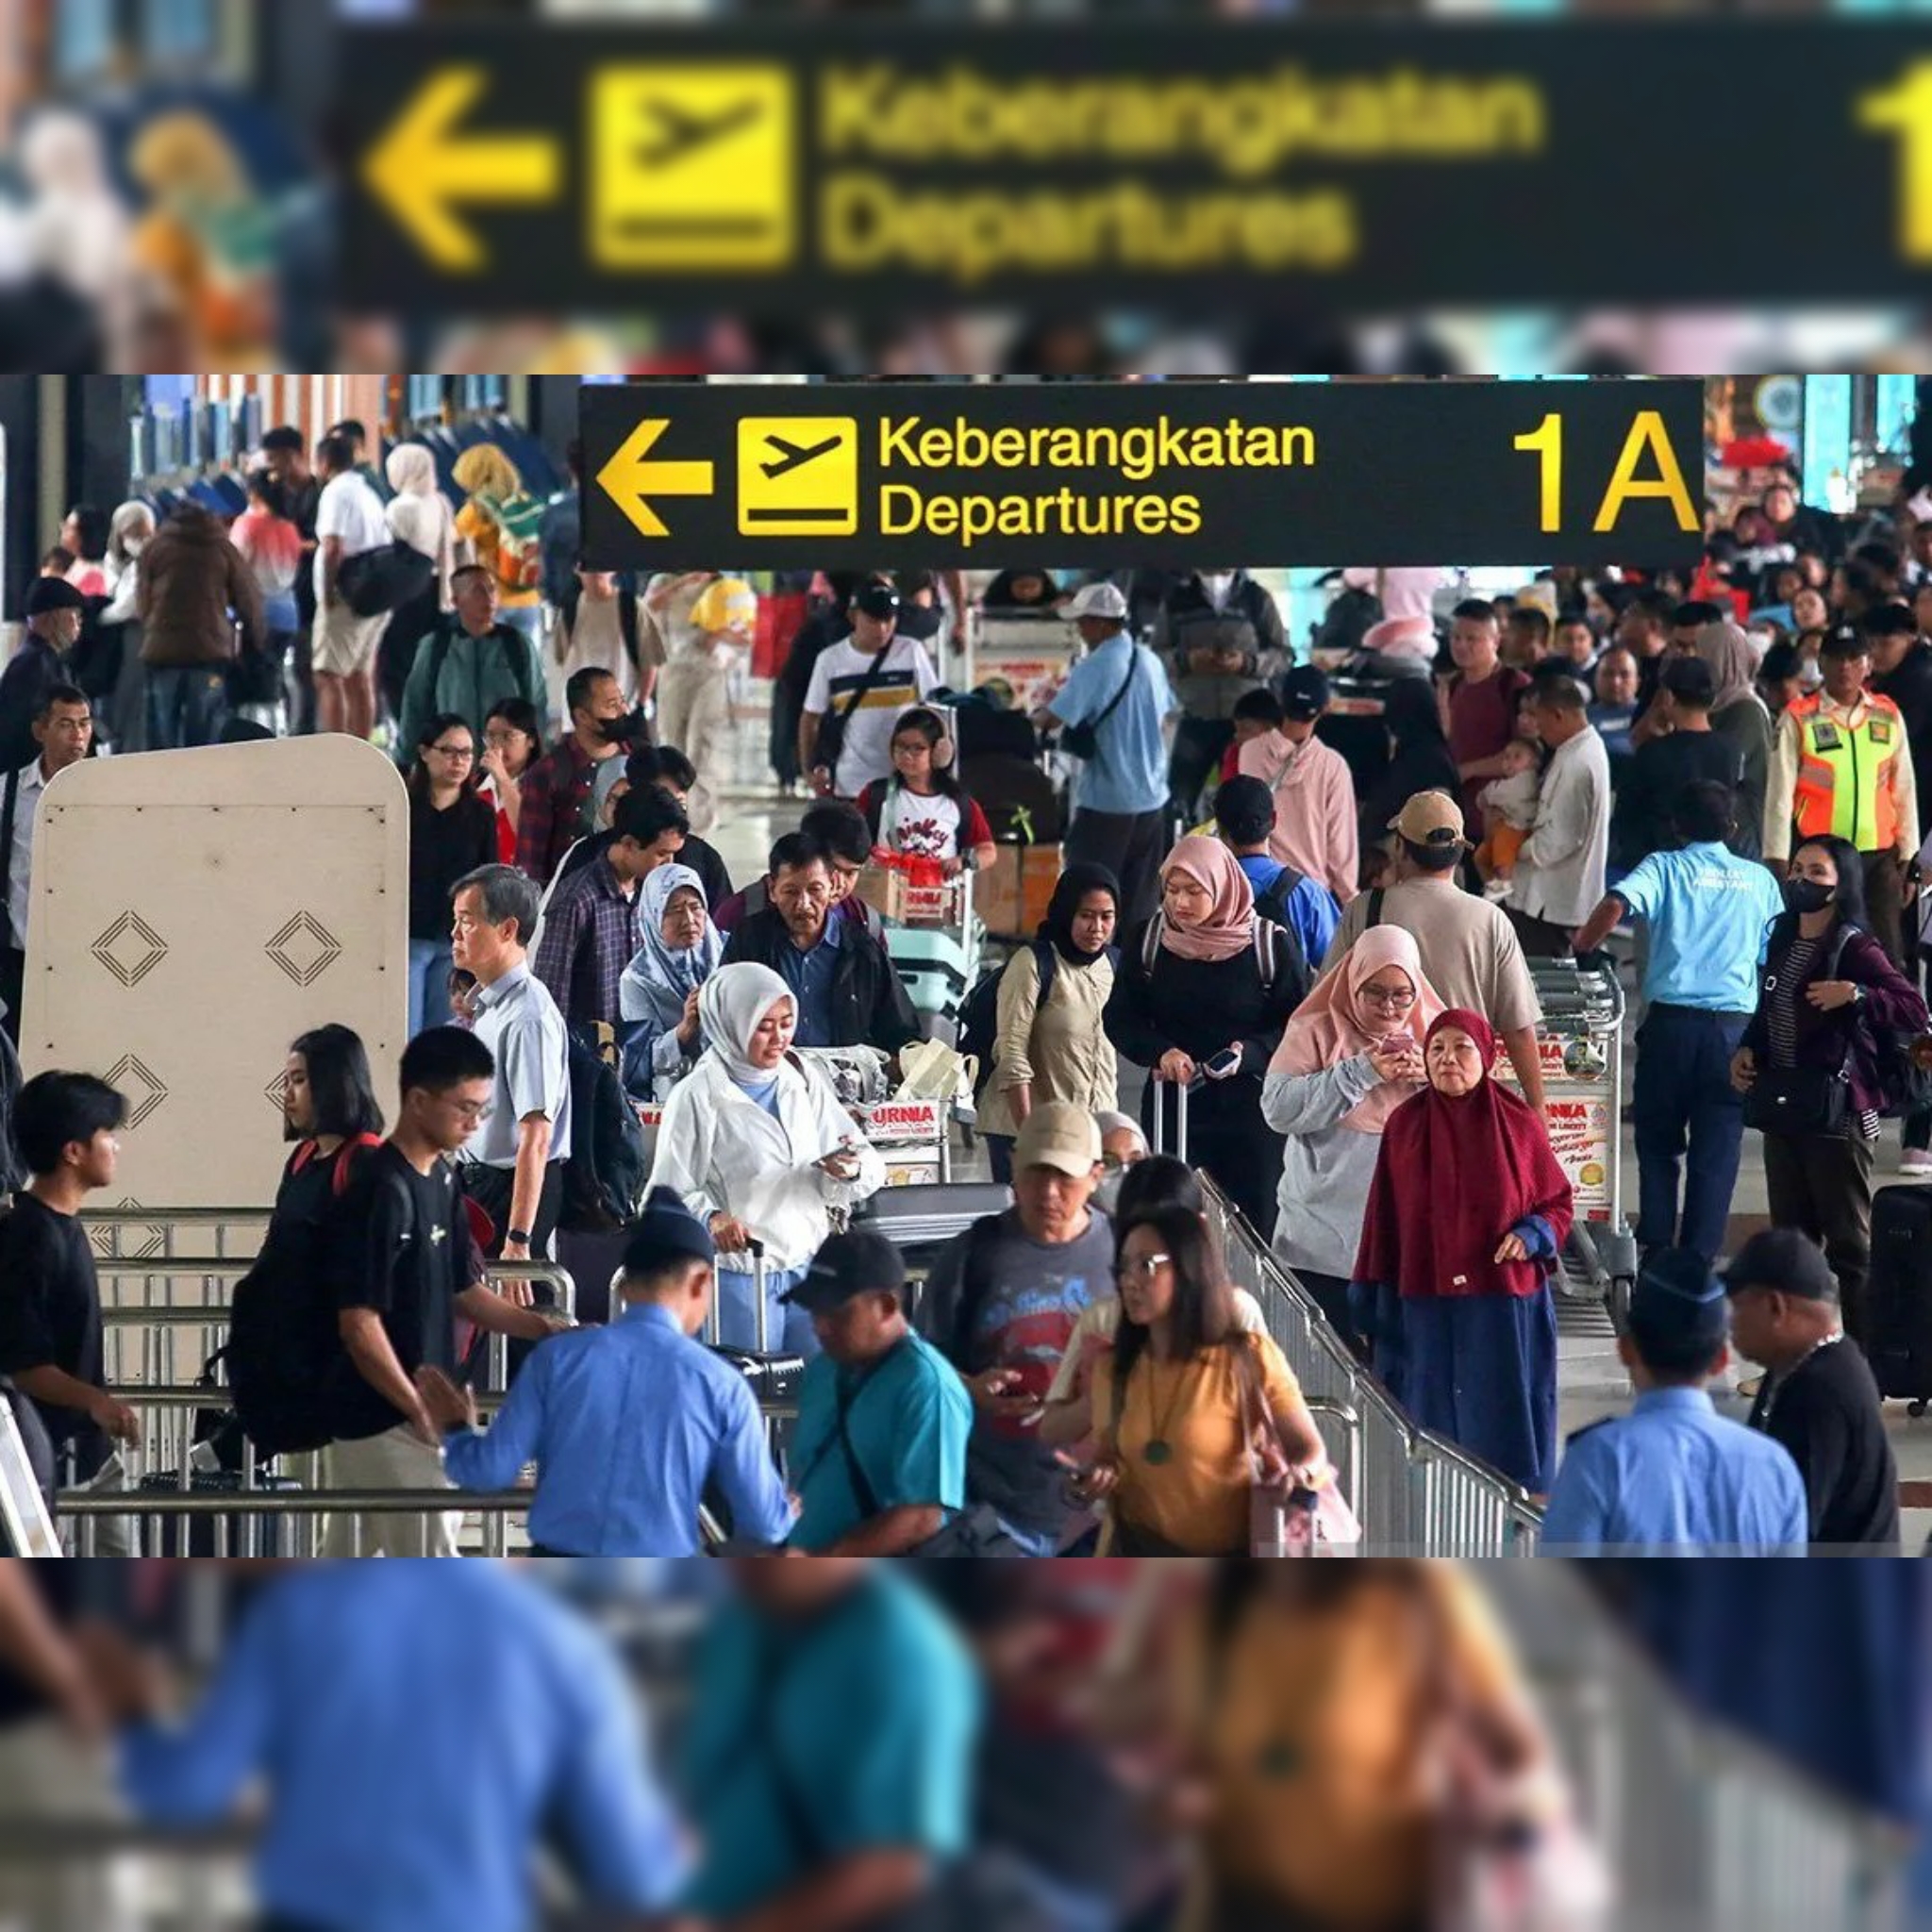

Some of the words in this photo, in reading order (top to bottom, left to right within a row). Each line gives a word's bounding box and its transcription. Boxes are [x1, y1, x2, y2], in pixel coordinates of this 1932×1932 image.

[822, 72, 1540, 170] Keberangkatan
[824, 181, 1351, 272] Departures
[879, 416, 1315, 479] Keberangkatan
[879, 484, 1202, 547] Departures
